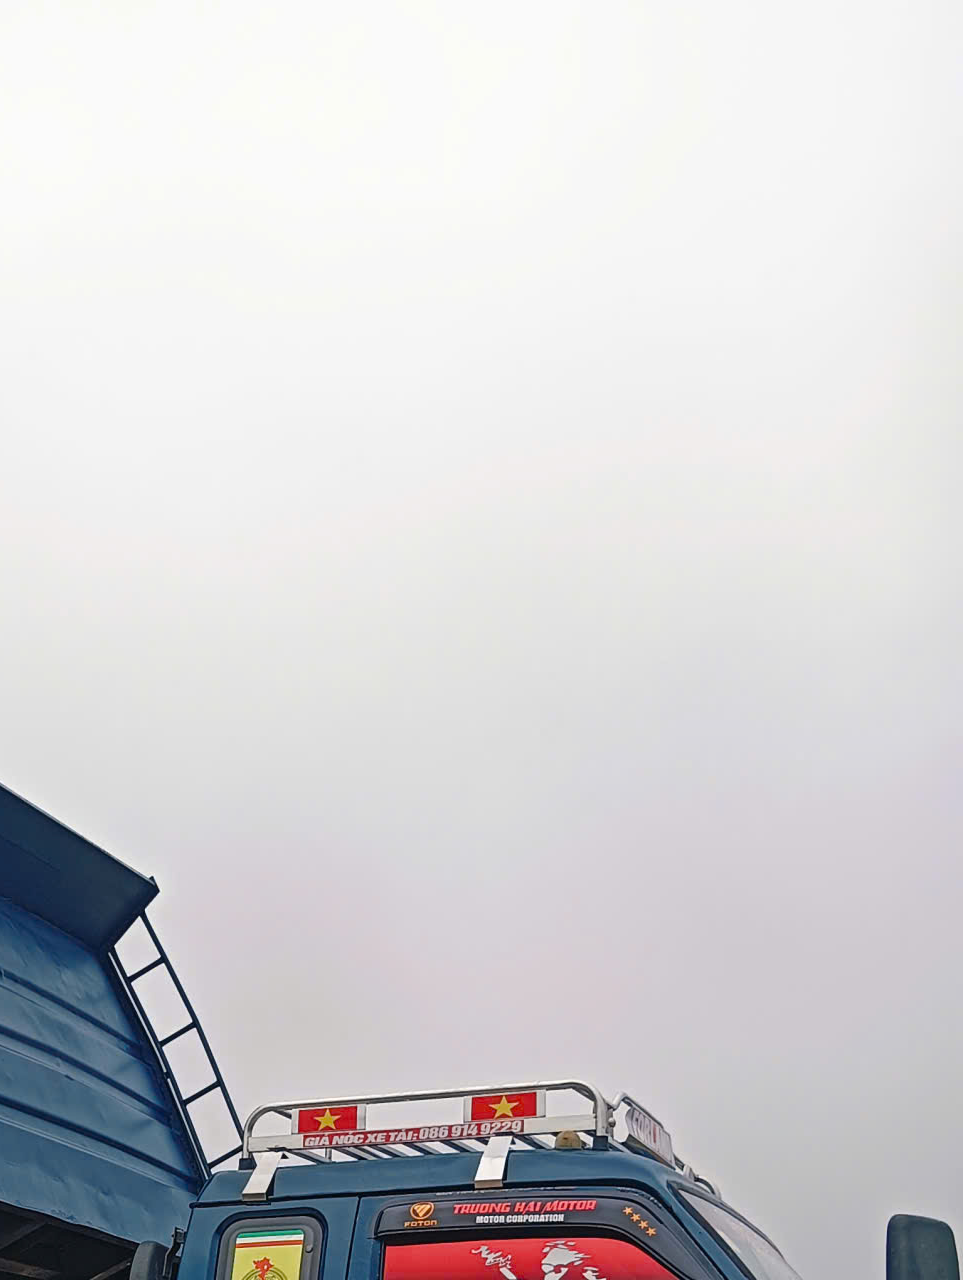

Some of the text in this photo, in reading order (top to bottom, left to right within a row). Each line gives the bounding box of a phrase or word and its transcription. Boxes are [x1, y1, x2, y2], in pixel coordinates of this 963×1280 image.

[304, 1134, 331, 1147] GIÁ
[365, 1131, 387, 1144] XE
[419, 1125, 449, 1141] 086
[451, 1123, 478, 1138] 914
[479, 1119, 523, 1135] 9229
[541, 1200, 597, 1214] MOTOR
[404, 1219, 438, 1228] FOTON
[476, 1213, 564, 1224] MOTOR CORPORATION
